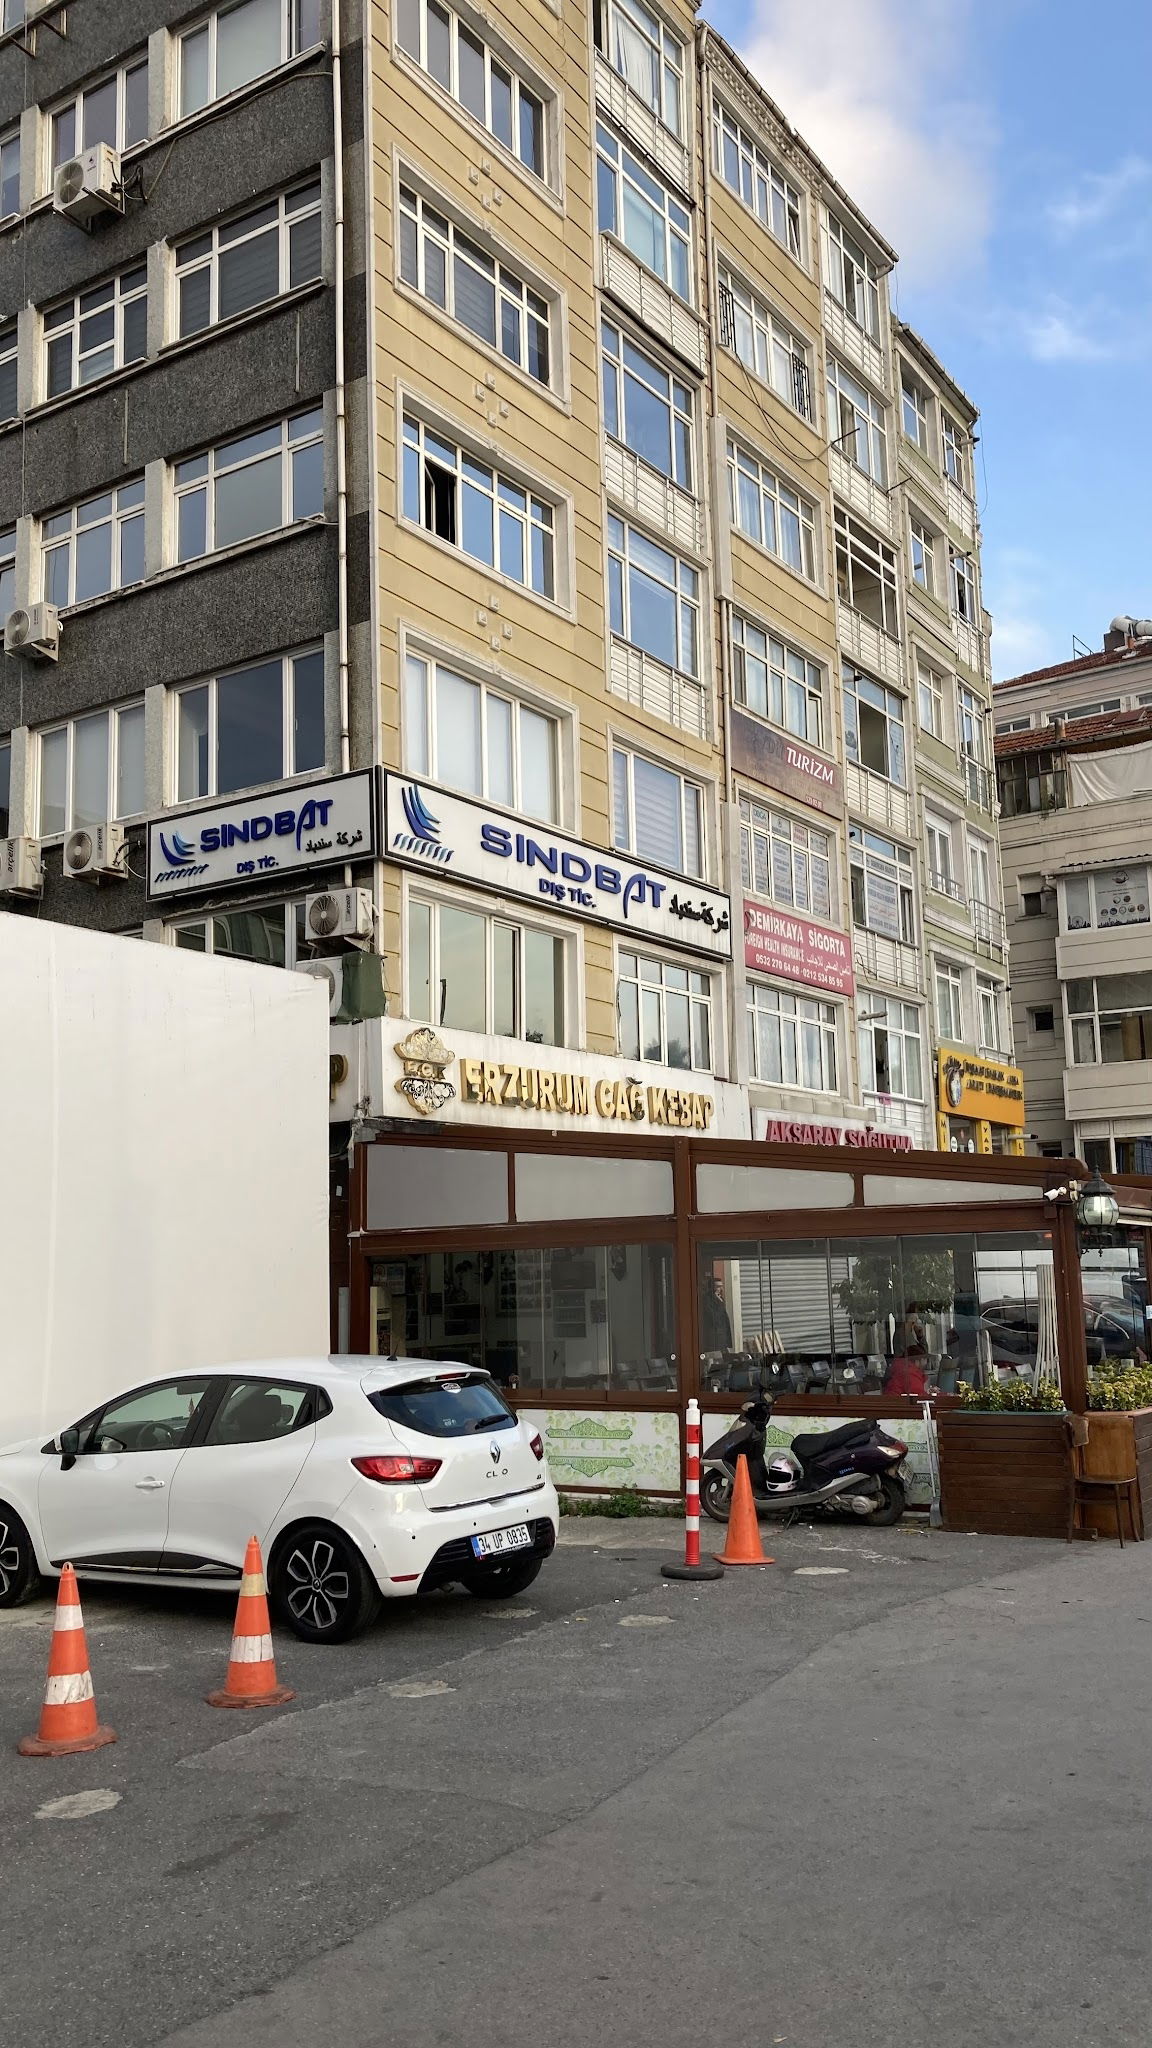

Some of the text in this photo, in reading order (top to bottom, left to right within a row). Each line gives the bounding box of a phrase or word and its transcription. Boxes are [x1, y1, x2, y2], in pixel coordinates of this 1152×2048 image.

[787, 747, 834, 784] TURİZM
[200, 799, 333, 852] SINDBAT
[236, 855, 280, 874] DIŞ TİC.
[480, 824, 667, 919] SINDBAT
[539, 878, 598, 908] DIŞ TİC.
[748, 909, 846, 958] DEMİRKAYA SİGORTA
[764, 936, 780, 955] HEALTH
[755, 953, 771, 967] 0532
[771, 957, 782, 972] 270
[783, 963, 791, 974] 64
[792, 965, 800, 975] 48
[817, 972, 828, 984] 534
[836, 978, 844, 988] 95
[460, 1058, 590, 1115] ERZURUM
[647, 1086, 714, 1130] KEBAP
[766, 1120, 914, 1150] AKSARAY SOĞUTMA
[478, 1536, 491, 1552] 34
[492, 1533, 503, 1549] UP
[506, 1527, 529, 1546] 0835
